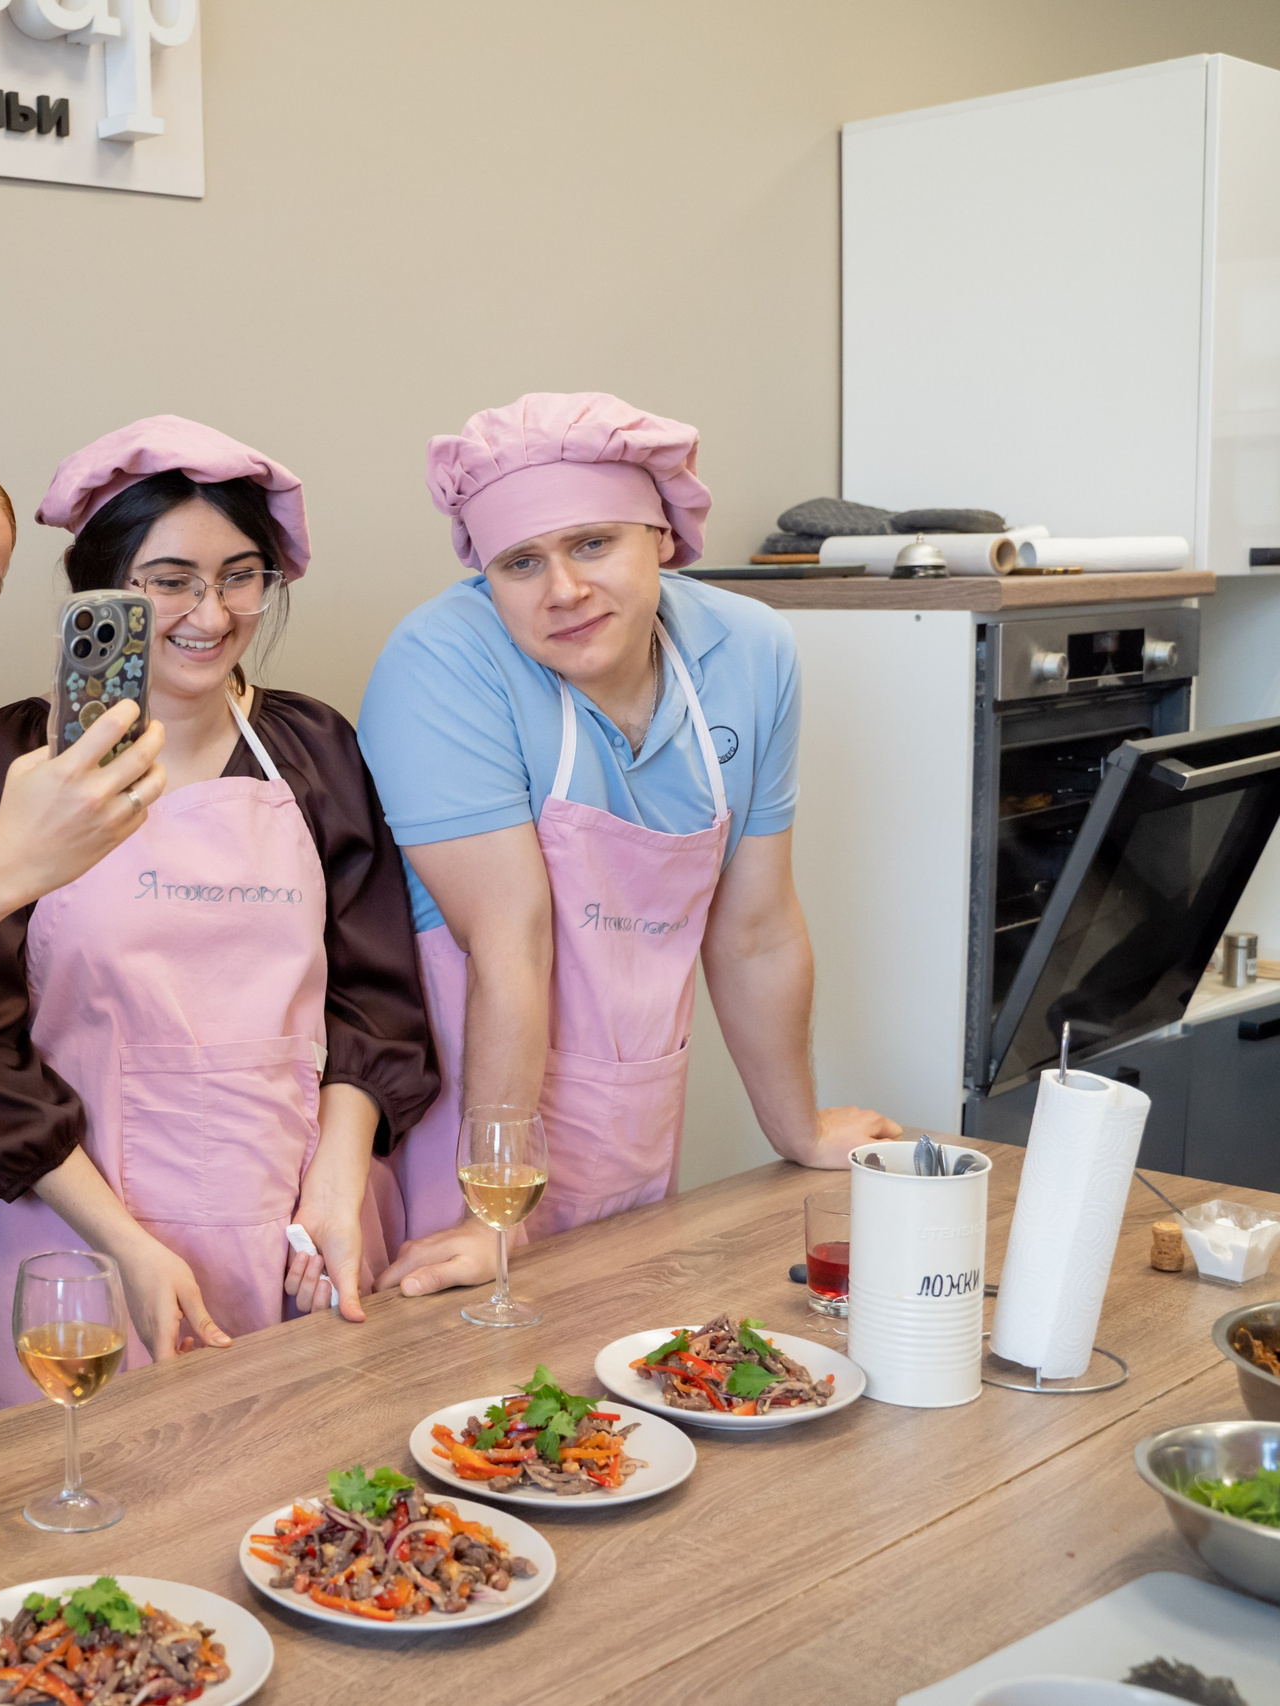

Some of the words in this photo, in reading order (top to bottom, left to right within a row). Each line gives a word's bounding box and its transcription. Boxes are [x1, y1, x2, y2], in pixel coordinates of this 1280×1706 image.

[134, 870, 158, 900] Я
[162, 884, 224, 902] тоже
[229, 886, 303, 904] повар
[579, 903, 601, 931] Я
[916, 1219, 984, 1240] UTENSILS
